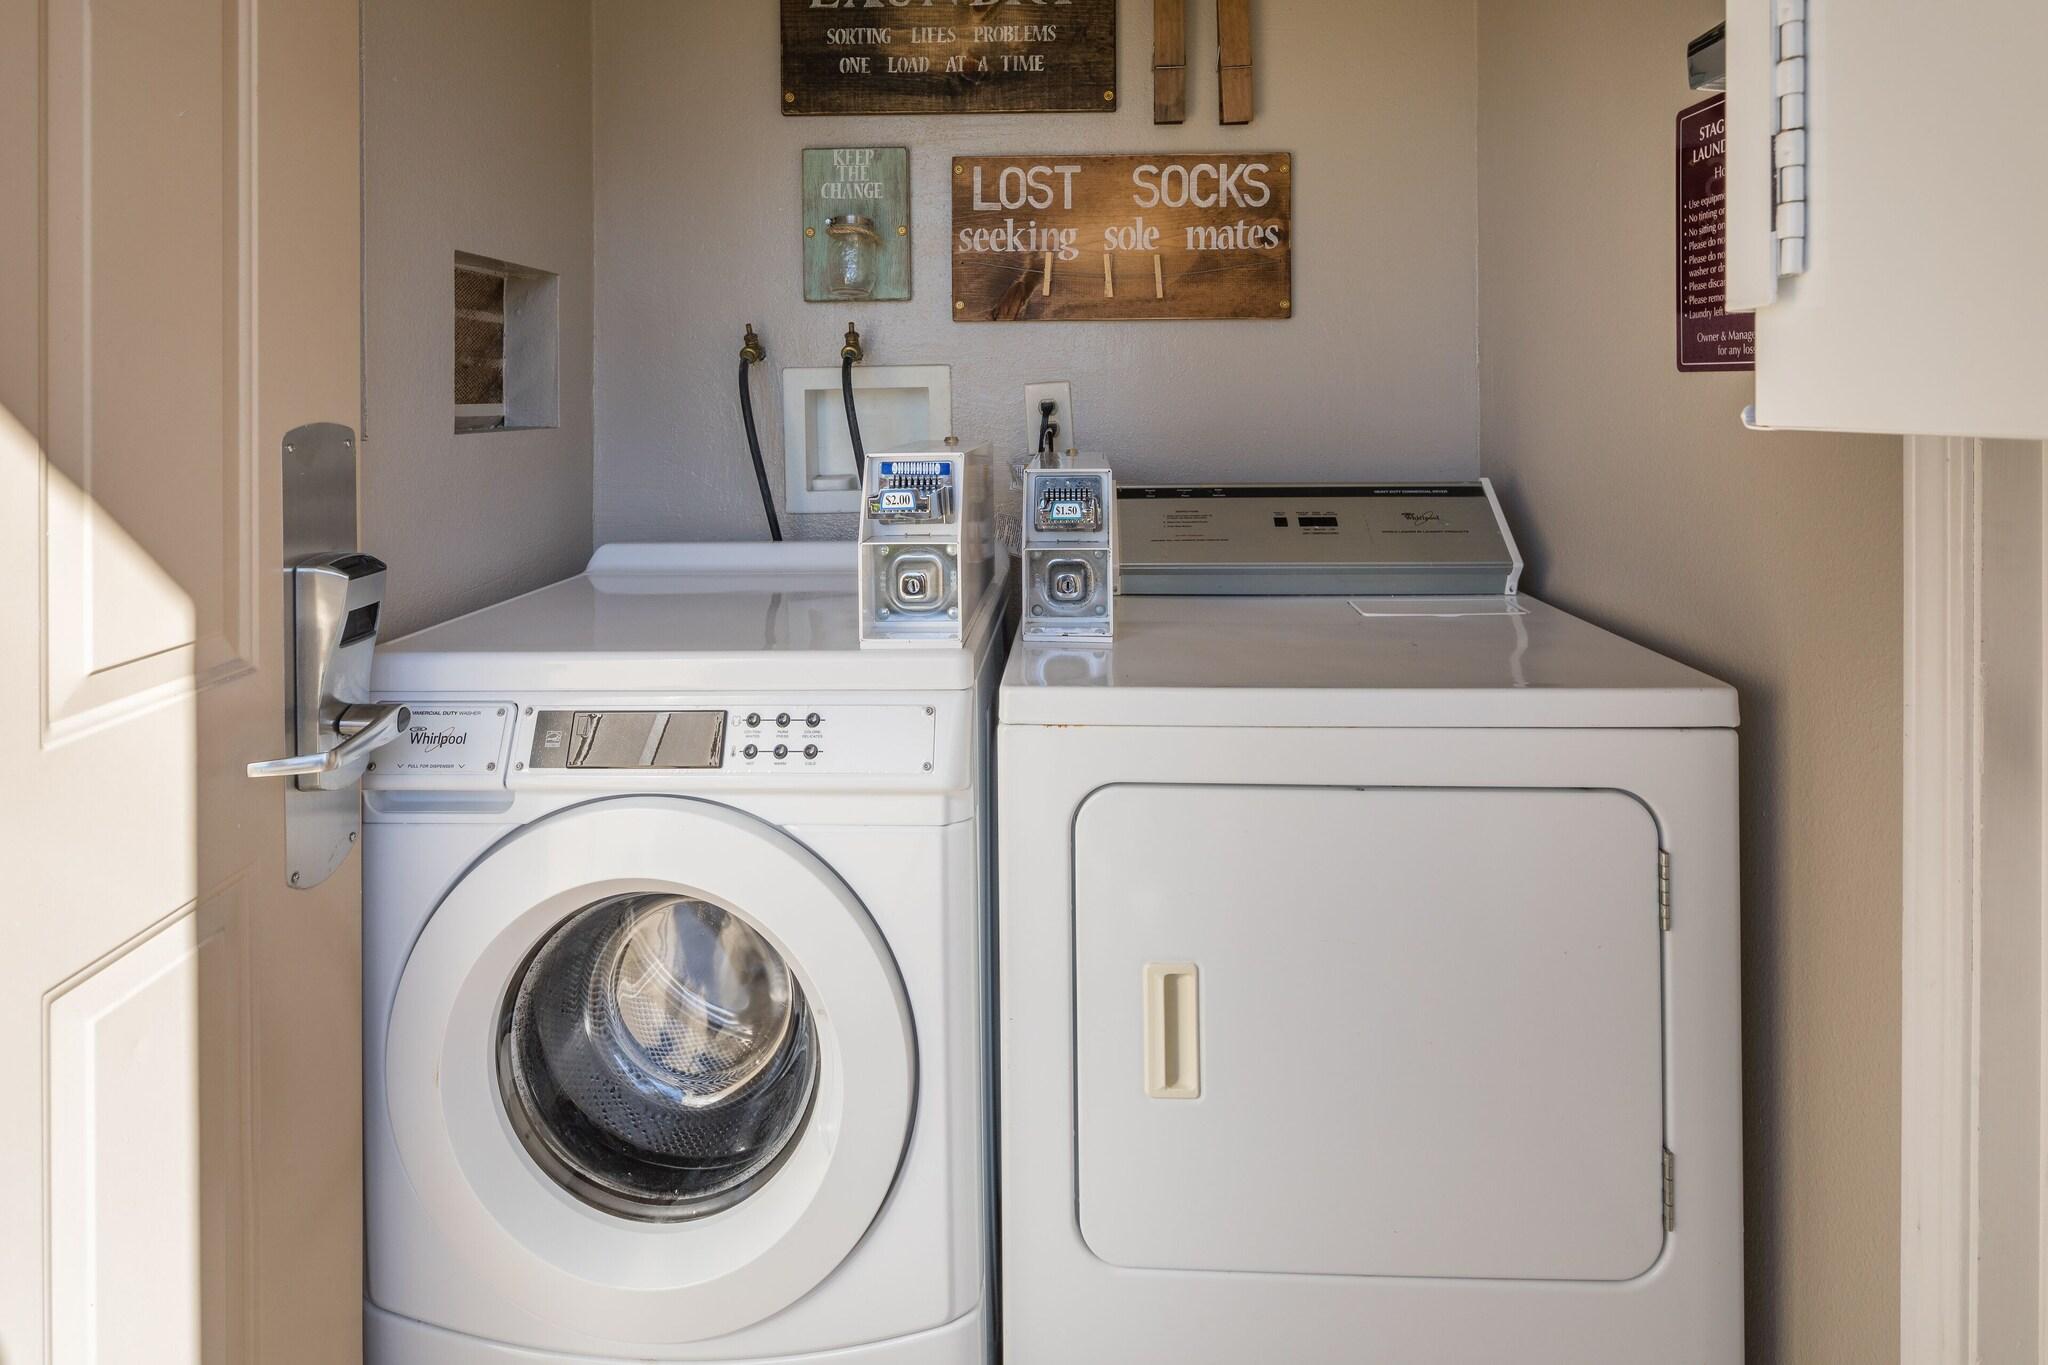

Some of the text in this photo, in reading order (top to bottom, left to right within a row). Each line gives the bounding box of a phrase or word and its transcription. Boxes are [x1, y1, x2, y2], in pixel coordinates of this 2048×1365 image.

[826, 27, 892, 45] SORTING
[974, 25, 1057, 43] PROBLEMS
[839, 55, 1045, 74] ONE LOAD AT A TIME
[1699, 118, 1726, 141] STAG
[832, 149, 874, 166] KEEP
[1692, 138, 1727, 163] LAUND
[837, 165, 870, 181] THE
[820, 182, 884, 199] CHANGE
[972, 163, 1271, 211] LOST SOCKS
[1688, 193, 1727, 209] Use equipm
[1688, 213, 1698, 223] No
[958, 216, 1280, 261] seeking sole mates
[1688, 227, 1698, 237] No
[1688, 240, 1708, 251] Please
[1707, 236, 1717, 247] do
[1688, 254, 1708, 265] Please
[1707, 251, 1717, 262] do
[1688, 266, 1709, 278] washer
[1688, 280, 1708, 292] Please
[1688, 294, 1726, 305] Please remo
[1689, 307, 1712, 320] Laundry
[1696, 332, 1720, 343] Owner
[1720, 331, 1727, 342] &
[1717, 344, 1727, 356] for
[1728, 346, 1742, 358] any
[885, 494, 911, 506] $2.00
[1055, 505, 1078, 516] $1.50
[410, 732, 467, 748] Whirlpool
